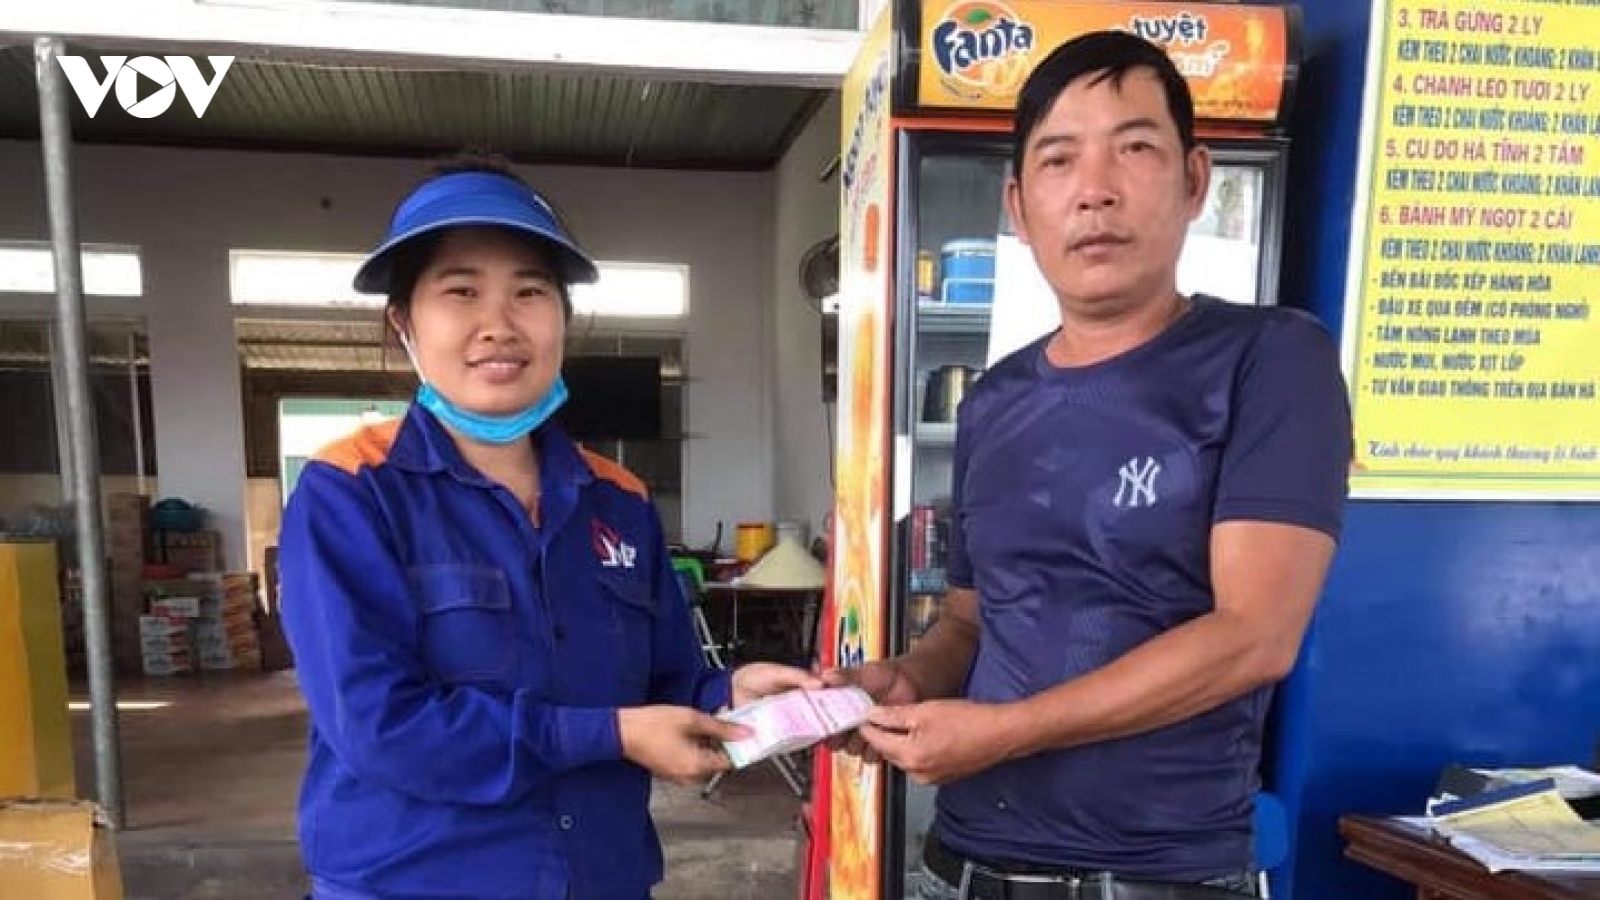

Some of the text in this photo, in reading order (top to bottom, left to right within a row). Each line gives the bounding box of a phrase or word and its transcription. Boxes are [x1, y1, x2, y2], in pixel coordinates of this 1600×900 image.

[1133, 13, 1206, 42] tuyệt
[1399, 8, 1412, 28] 3.
[1508, 15, 1518, 35] 2
[1522, 17, 1542, 36] LY
[932, 18, 1034, 74] Fanta
[1449, 41, 1457, 65] 2
[1393, 75, 1406, 94] 4.
[1413, 73, 1471, 97] CHANH
[1477, 77, 1507, 99] LEO
[1555, 82, 1564, 101] 2
[1569, 83, 1589, 102] LY
[1444, 106, 1451, 128] 2
[1386, 138, 1401, 159] 5.
[1406, 138, 1429, 159] CU
[1534, 144, 1542, 164] 2
[1437, 170, 1444, 193] 2
[1380, 206, 1393, 224] 6.
[1531, 210, 1540, 230] 2
[1431, 239, 1438, 262] 2
[1407, 299, 1422, 317] XE
[1426, 300, 1451, 318] QUA
[1480, 327, 1509, 346] THEO
[1418, 380, 1446, 397] GIAO
[1113, 457, 1161, 506] NY
